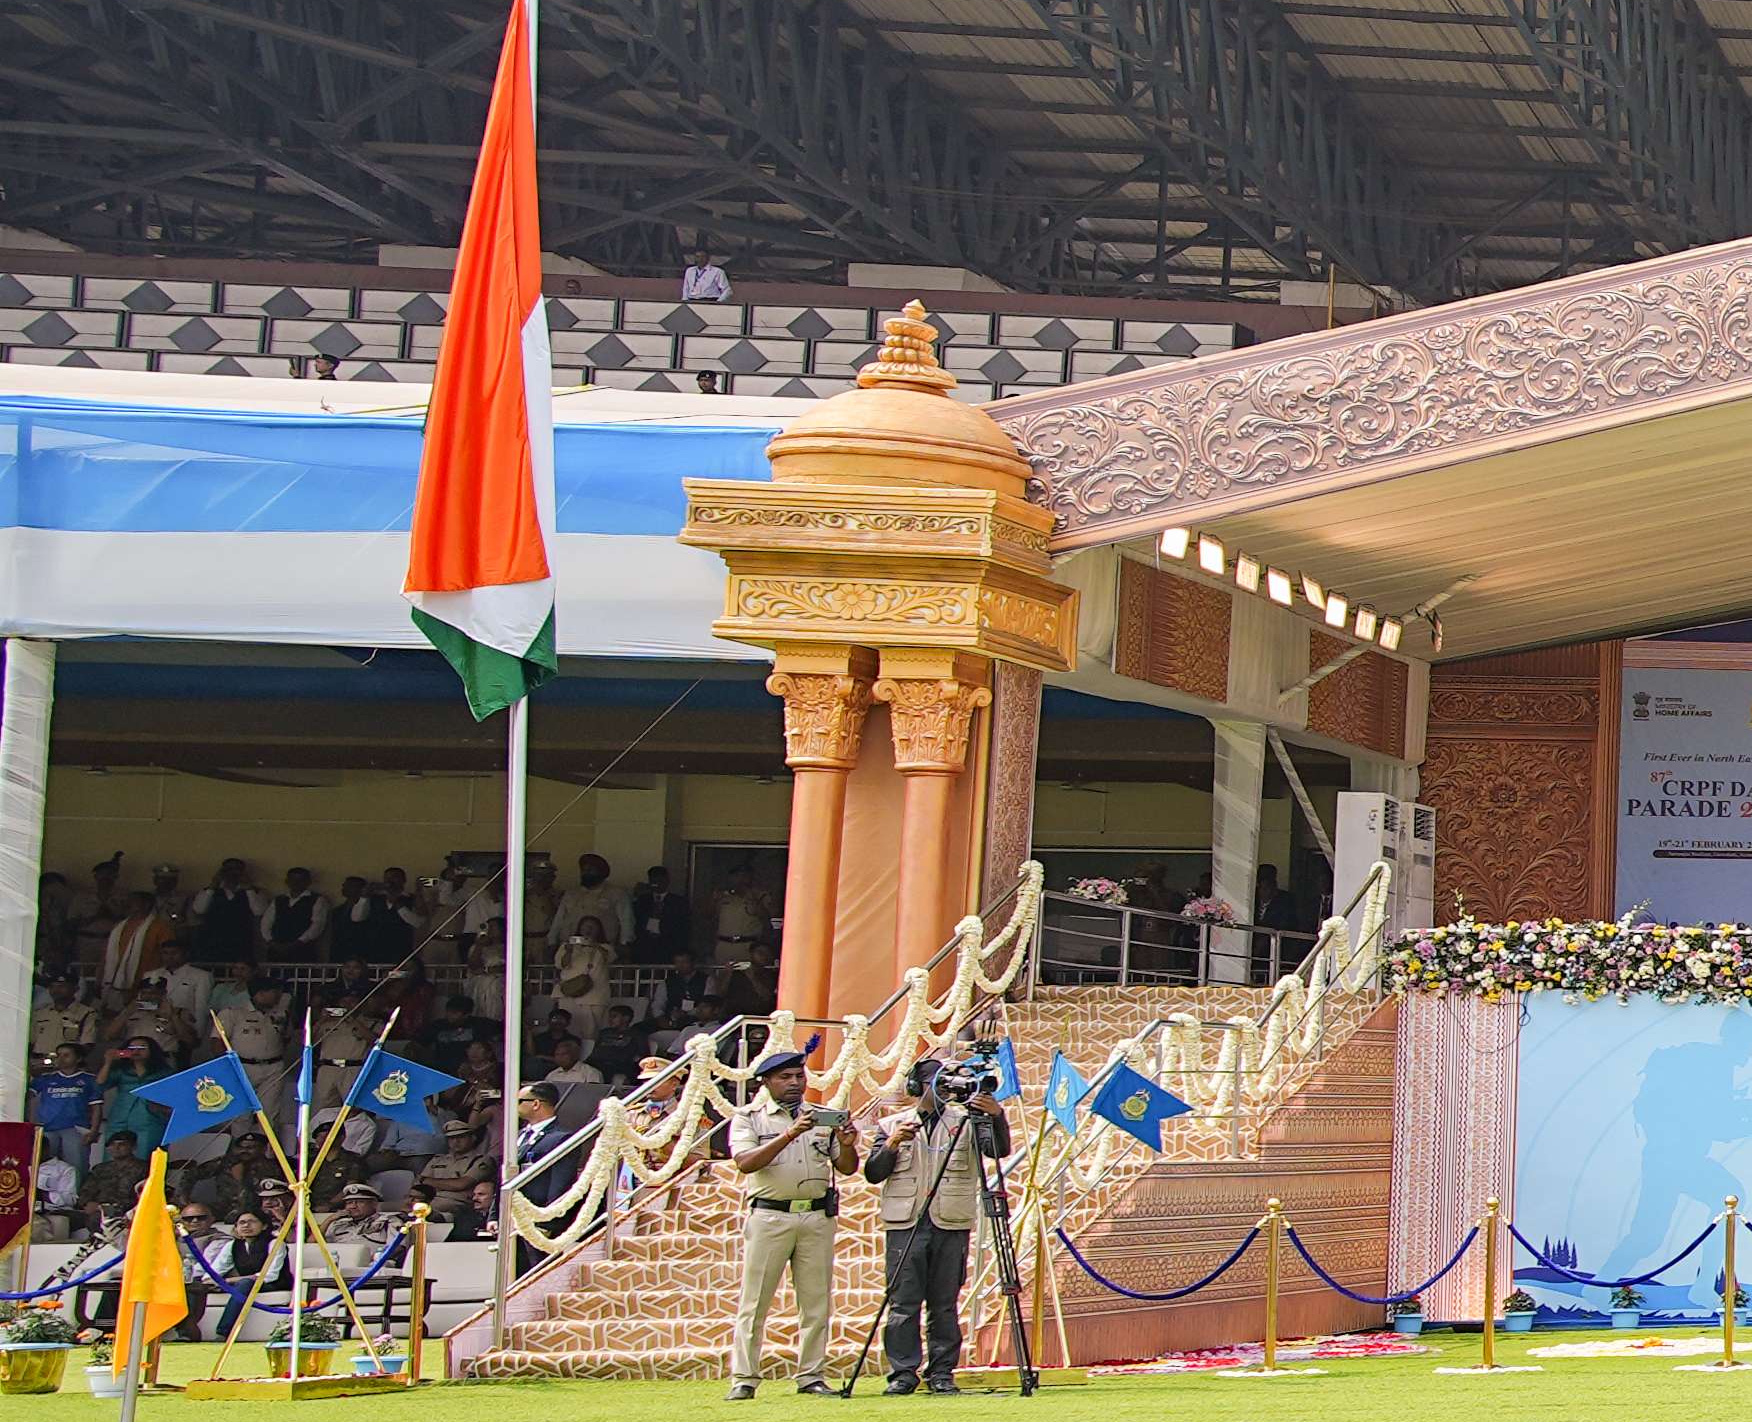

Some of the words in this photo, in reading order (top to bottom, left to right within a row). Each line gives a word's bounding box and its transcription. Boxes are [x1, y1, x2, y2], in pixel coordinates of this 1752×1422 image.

[1644, 752, 1667, 761] First
[1669, 753, 1692, 762] Ever
[1694, 753, 1704, 762] in
[1706, 754, 1735, 763] North
[1662, 779, 1725, 797] CRPF
[1626, 798, 1732, 818] PARADE
[1691, 840, 1744, 849] FEBRUARY
